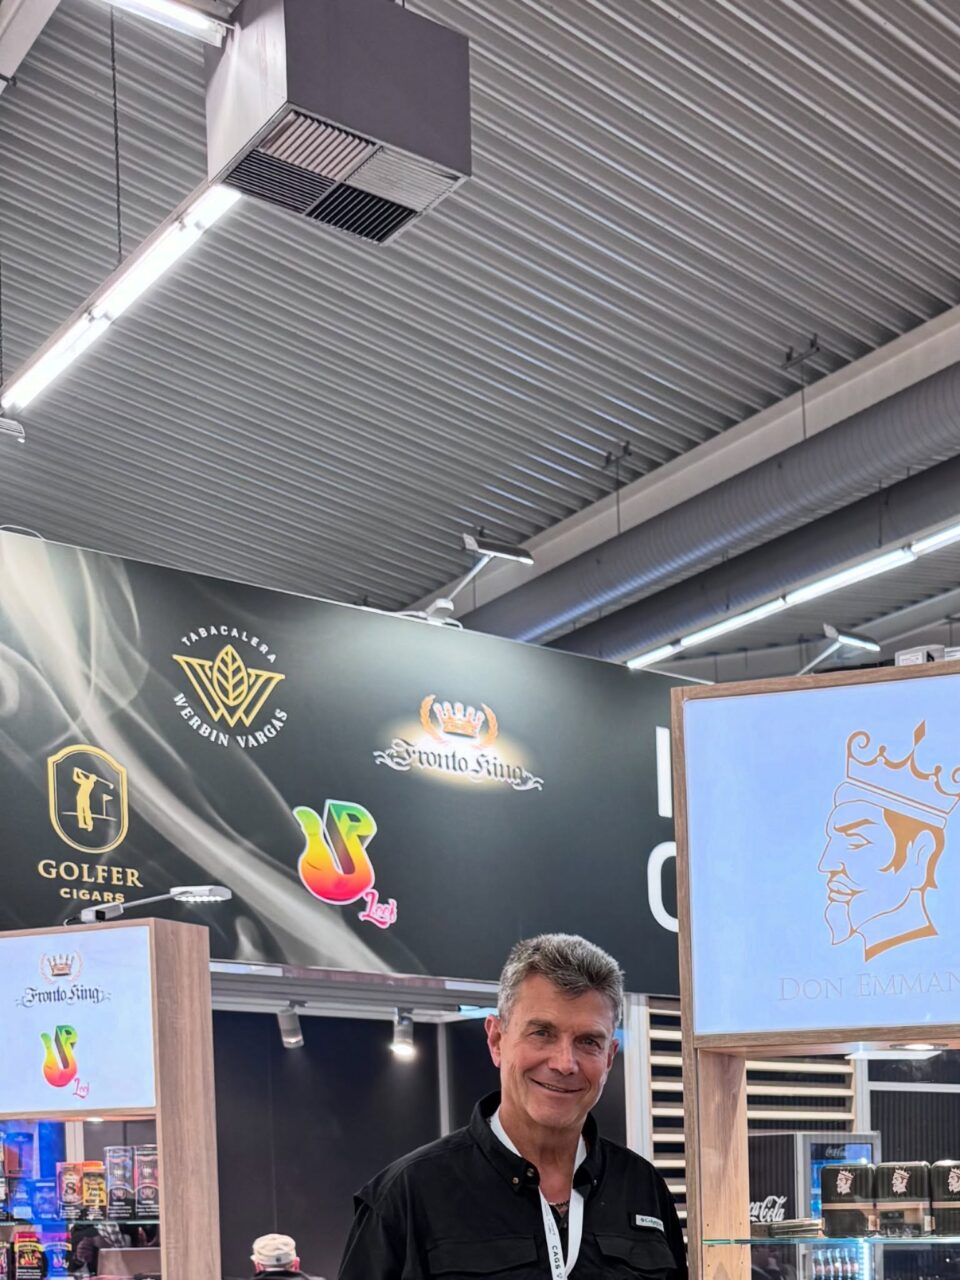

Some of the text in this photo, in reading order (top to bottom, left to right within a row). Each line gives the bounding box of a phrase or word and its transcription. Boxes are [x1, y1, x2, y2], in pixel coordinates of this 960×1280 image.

[181, 625, 277, 664] TABACALERA
[173, 692, 288, 749] WERBIN VARGAS
[379, 738, 531, 787] Fronto King
[37, 859, 144, 888] GOLFER
[59, 887, 125, 904] CIGARS
[20, 984, 104, 1008] Fronto King
[779, 976, 843, 1001] DON
